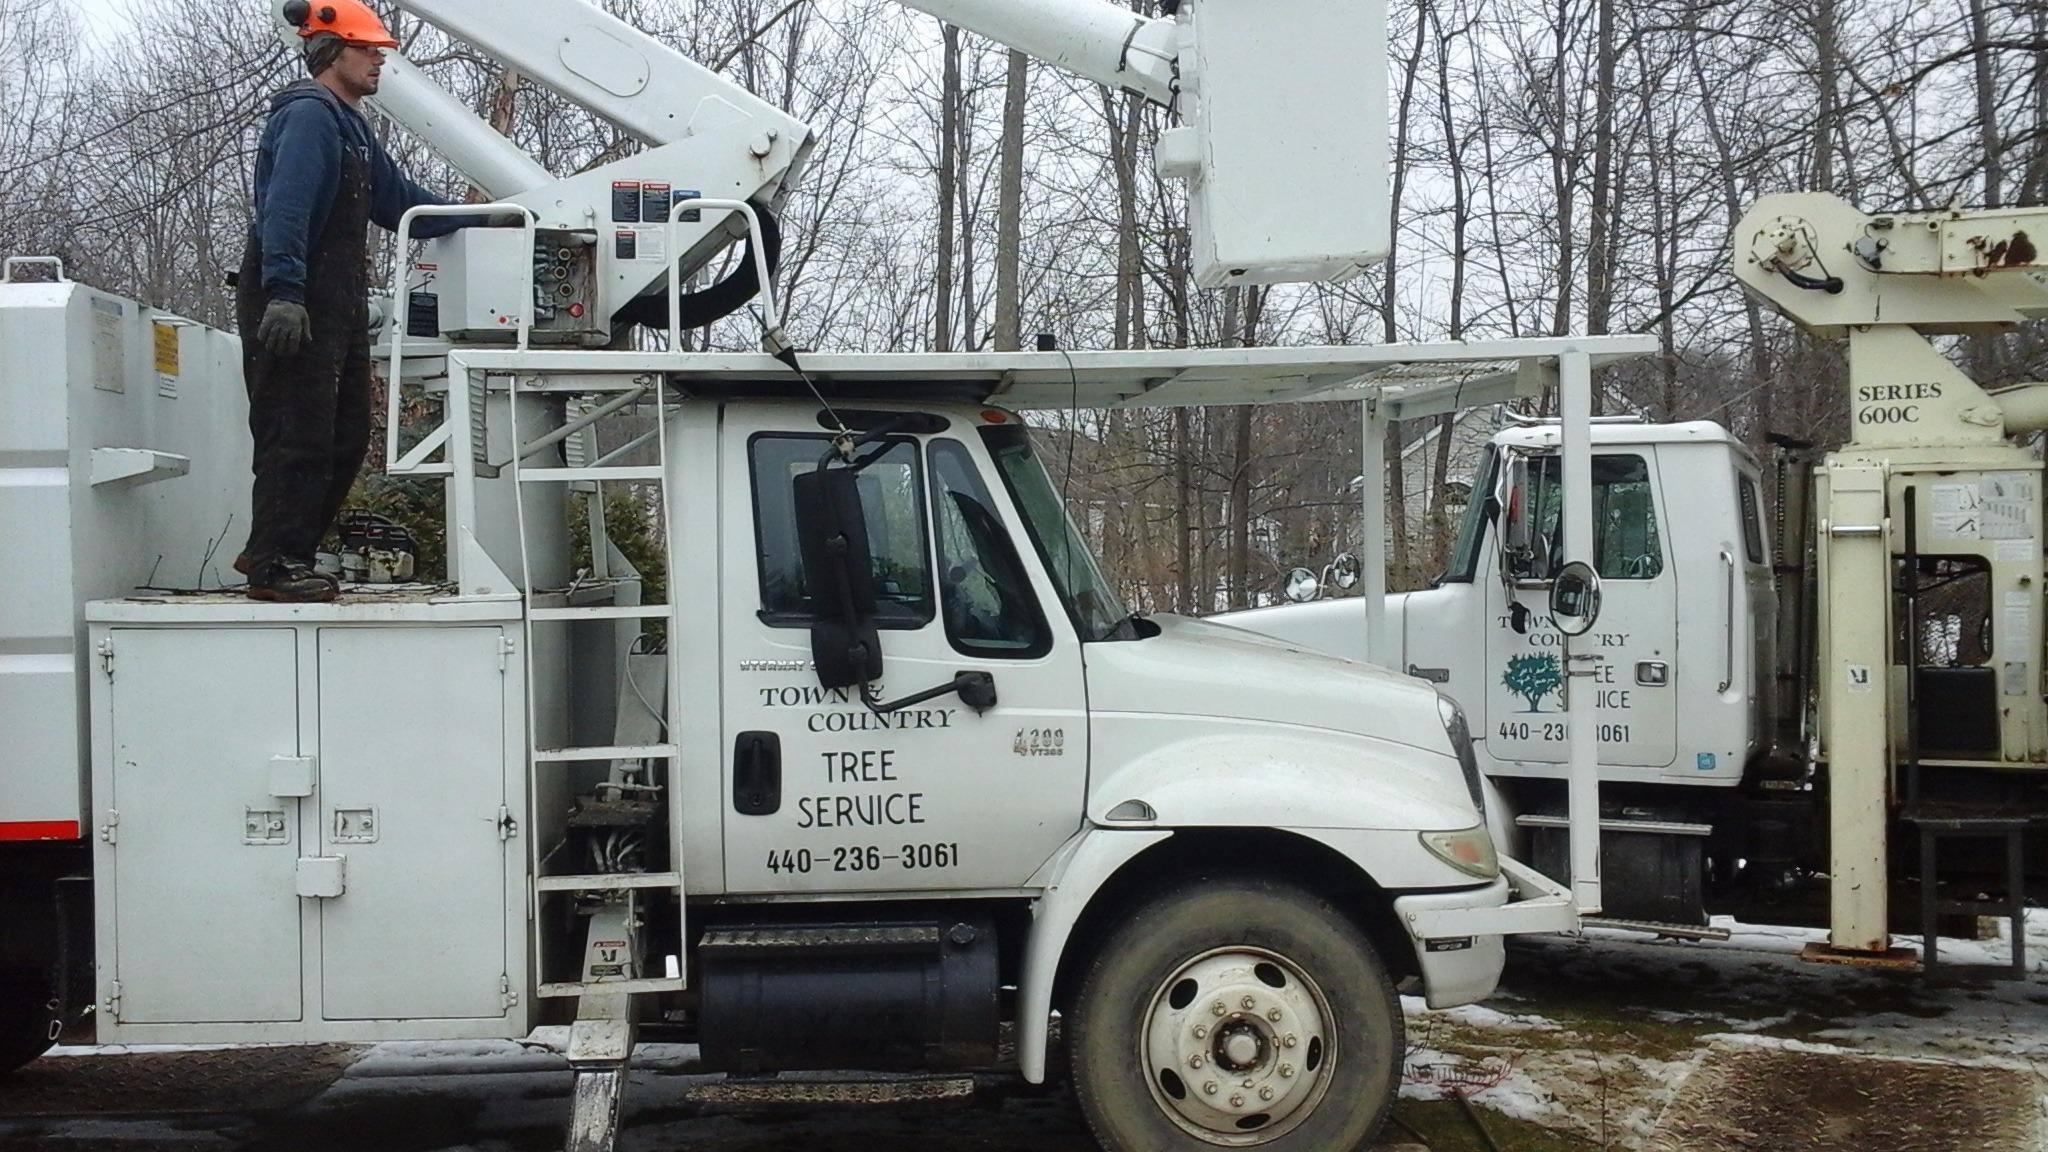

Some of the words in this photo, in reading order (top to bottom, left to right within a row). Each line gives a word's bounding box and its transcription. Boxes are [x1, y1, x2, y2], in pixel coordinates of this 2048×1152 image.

[1858, 382, 1943, 402] SERIES
[1858, 404, 1920, 425] 600C
[1528, 633, 1630, 647] CORY
[759, 686, 850, 707] TOWN
[807, 709, 957, 733] COUNTRY
[1499, 722, 1630, 743] 440-23061
[821, 750, 898, 783] TREE
[797, 793, 926, 829] SERVICE
[766, 843, 958, 874] 440-236-3061
